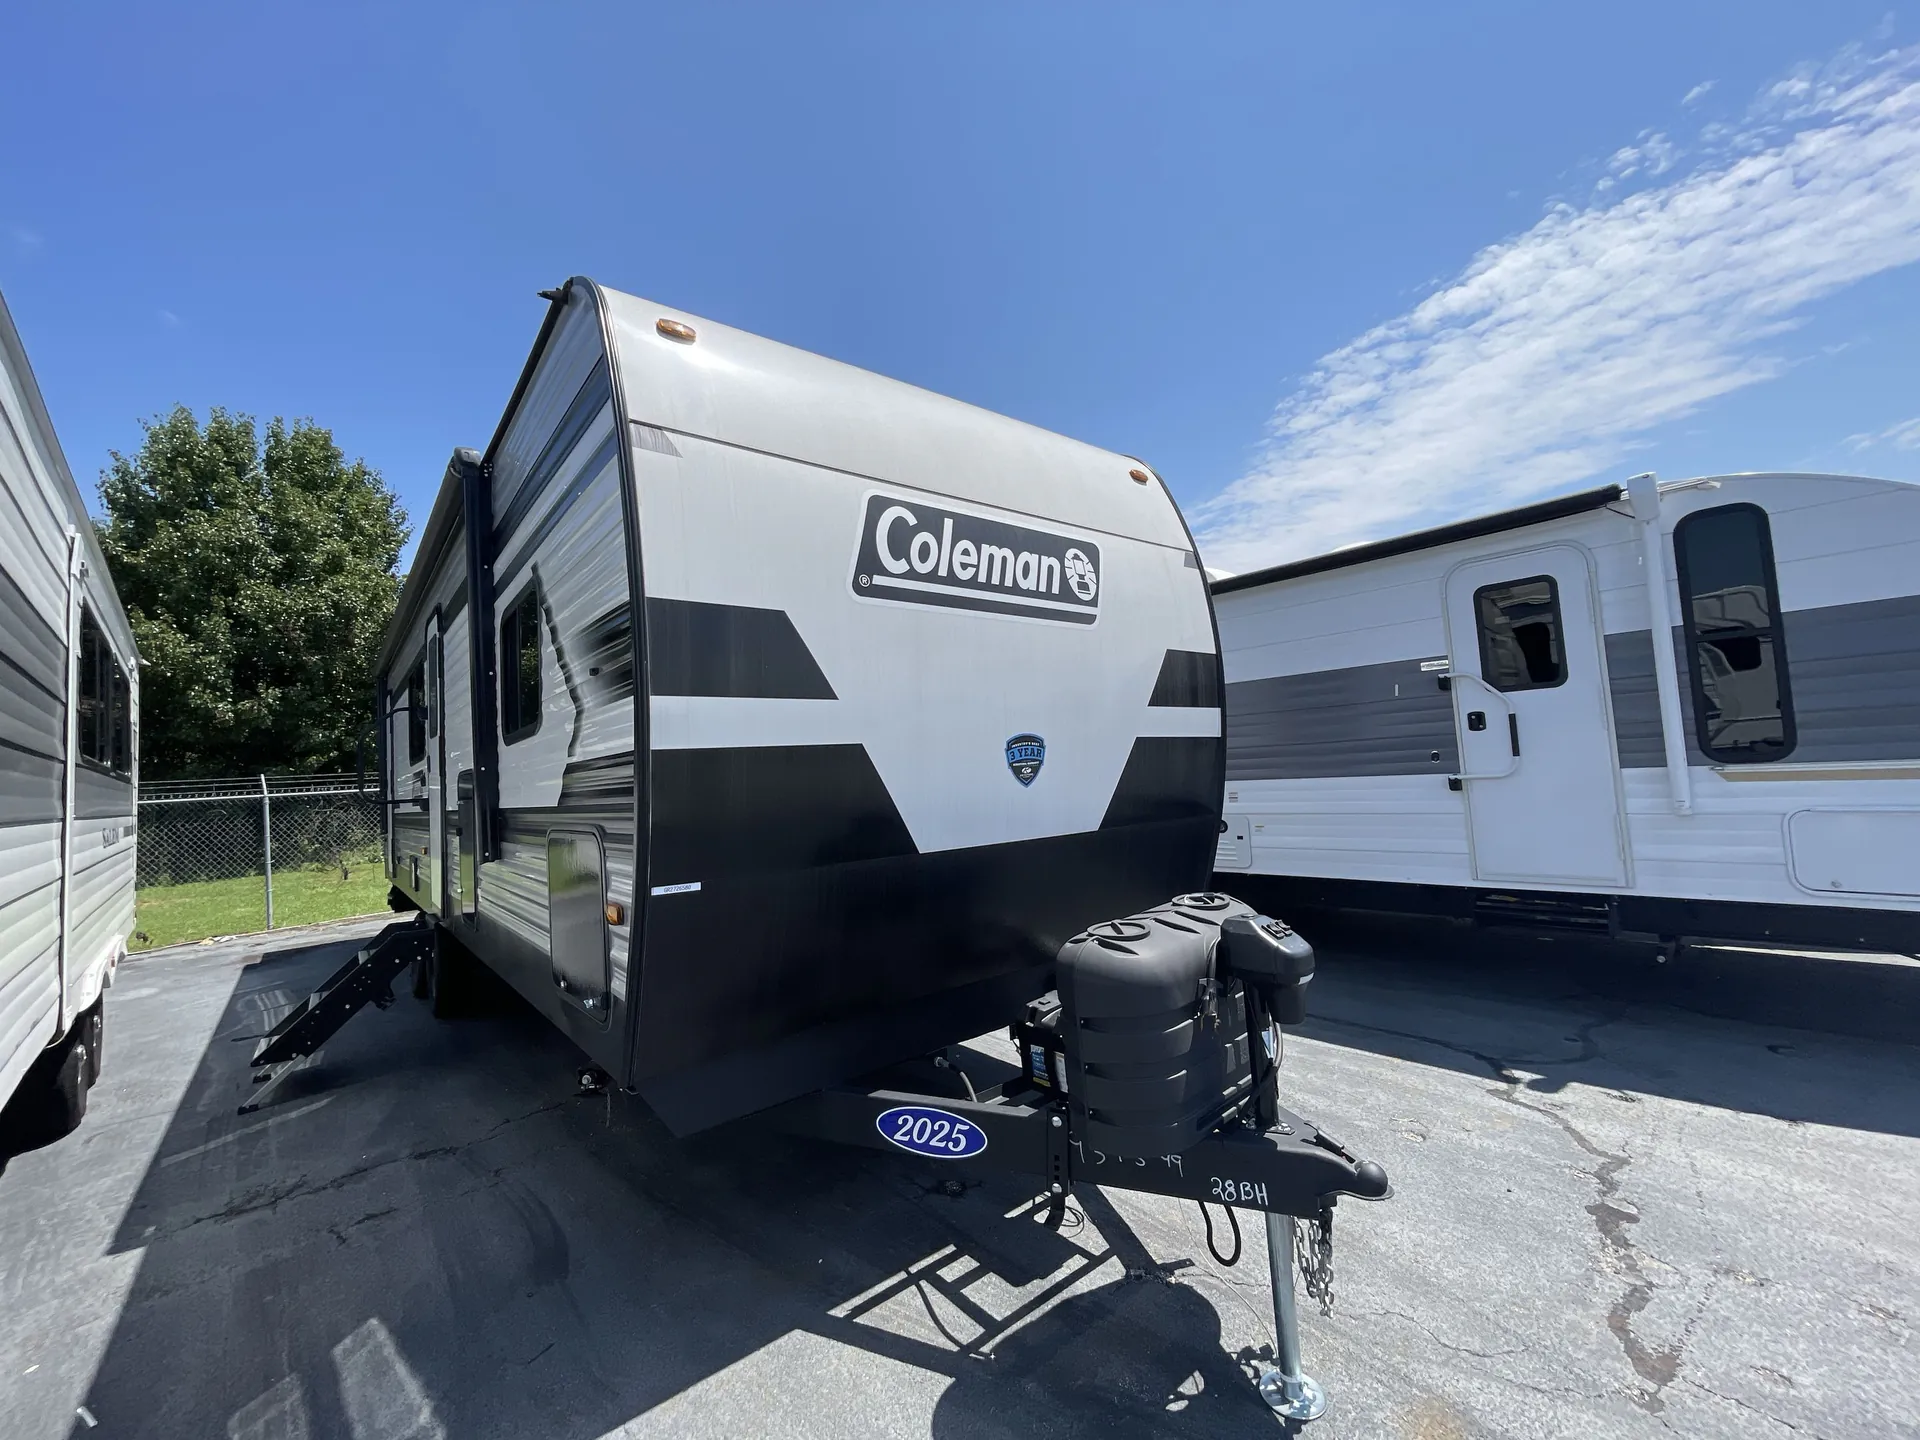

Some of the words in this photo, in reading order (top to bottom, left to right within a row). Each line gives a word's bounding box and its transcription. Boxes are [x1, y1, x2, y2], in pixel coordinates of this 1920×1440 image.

[876, 505, 1061, 595] Coleman
[1010, 750, 1016, 761] 3
[1017, 747, 1042, 759] YEAR
[893, 1115, 970, 1152] 2025
[1210, 1176, 1269, 1206] 28BH
